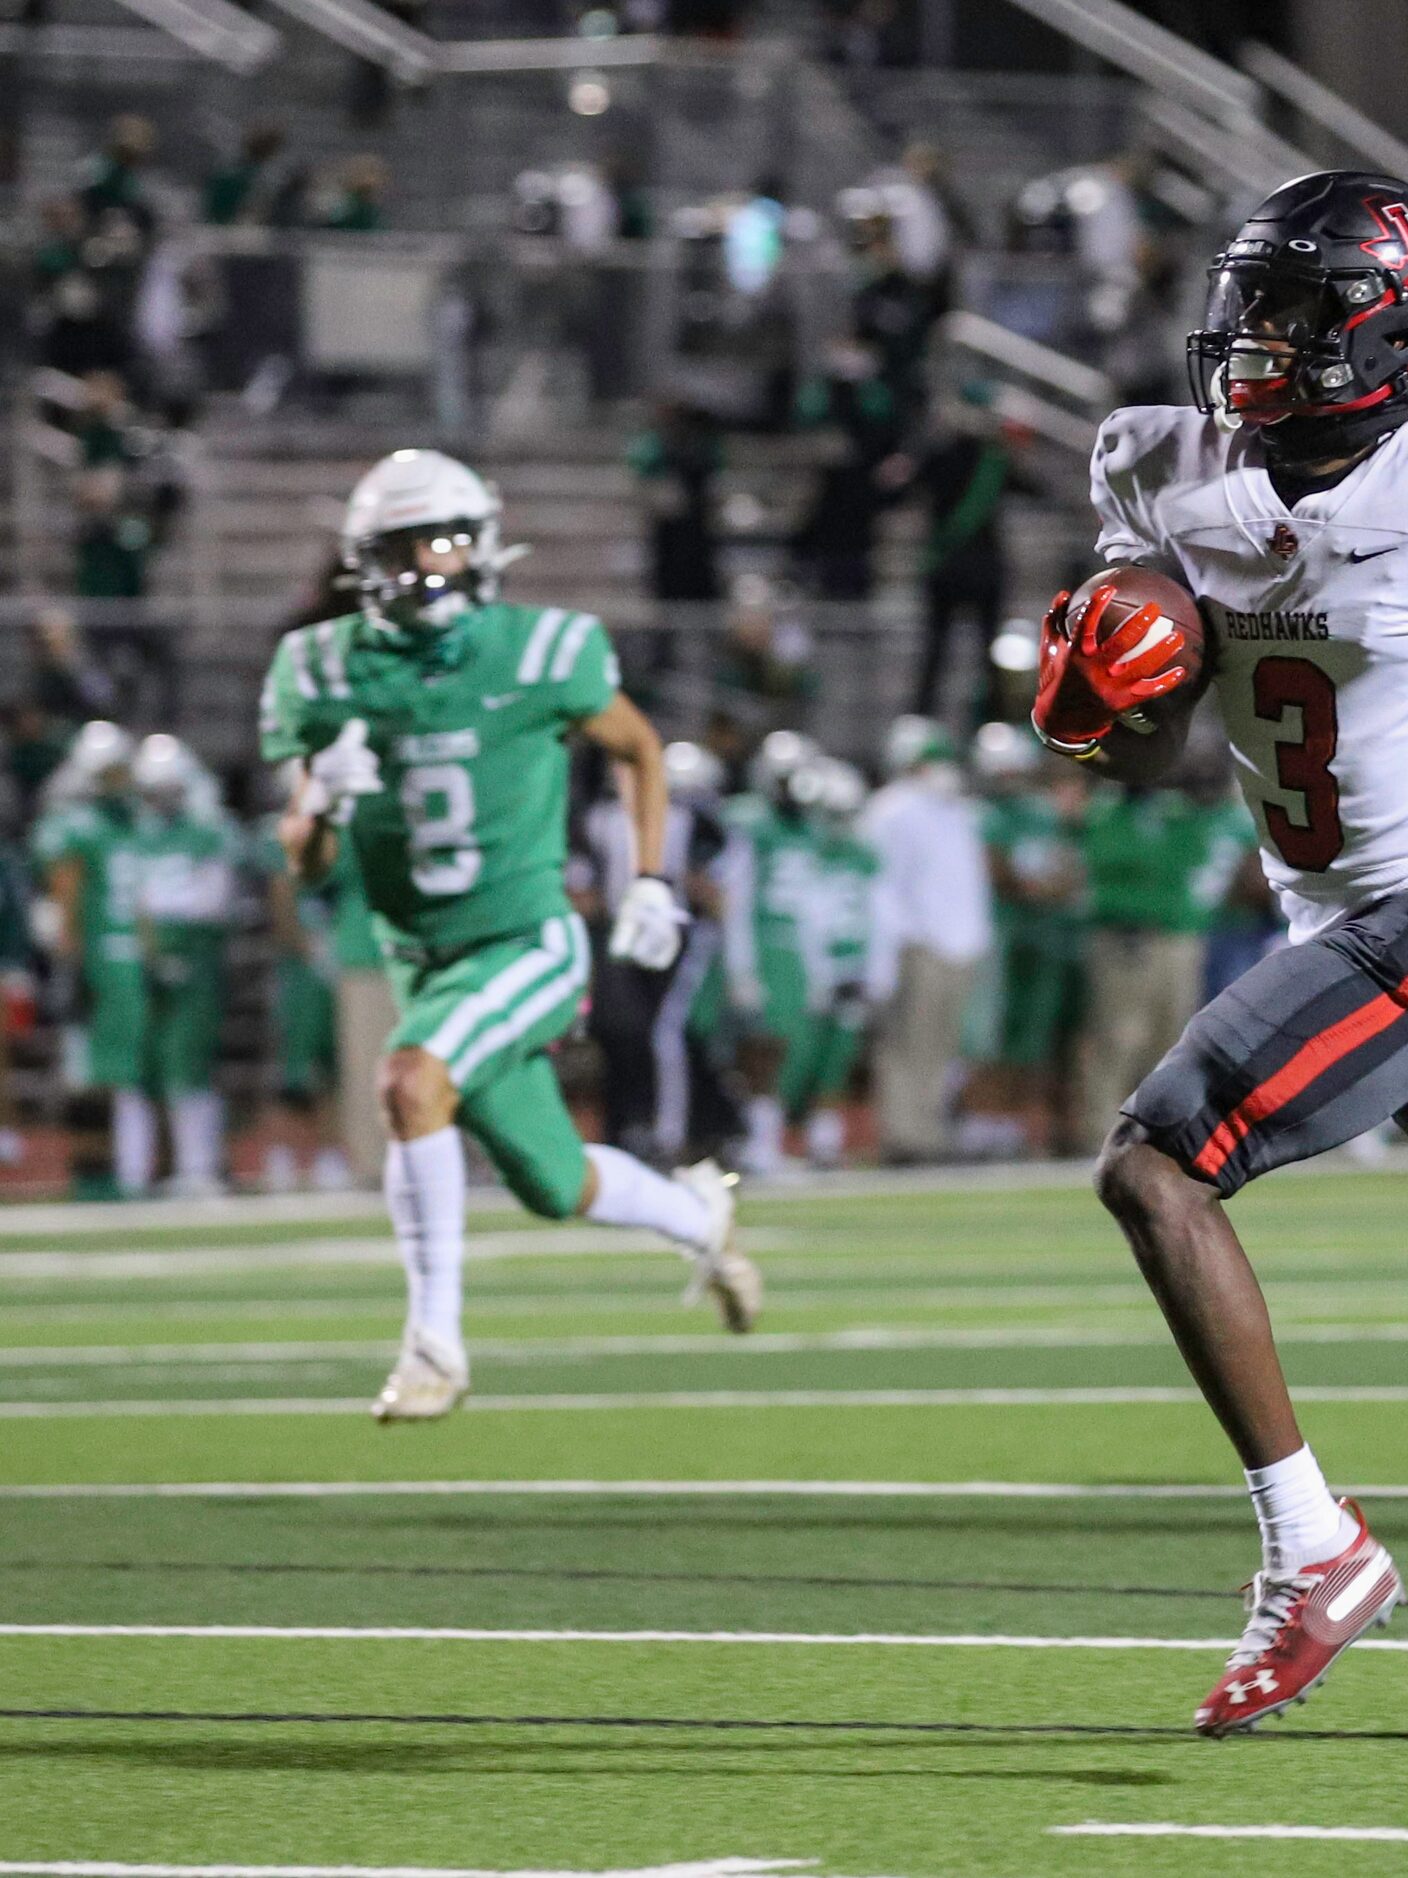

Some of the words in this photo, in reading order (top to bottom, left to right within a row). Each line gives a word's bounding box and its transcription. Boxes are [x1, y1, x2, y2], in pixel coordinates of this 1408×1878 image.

[1225, 611, 1330, 641] REDHAWKS
[401, 763, 482, 896] 8
[1252, 655, 1344, 873] 3
